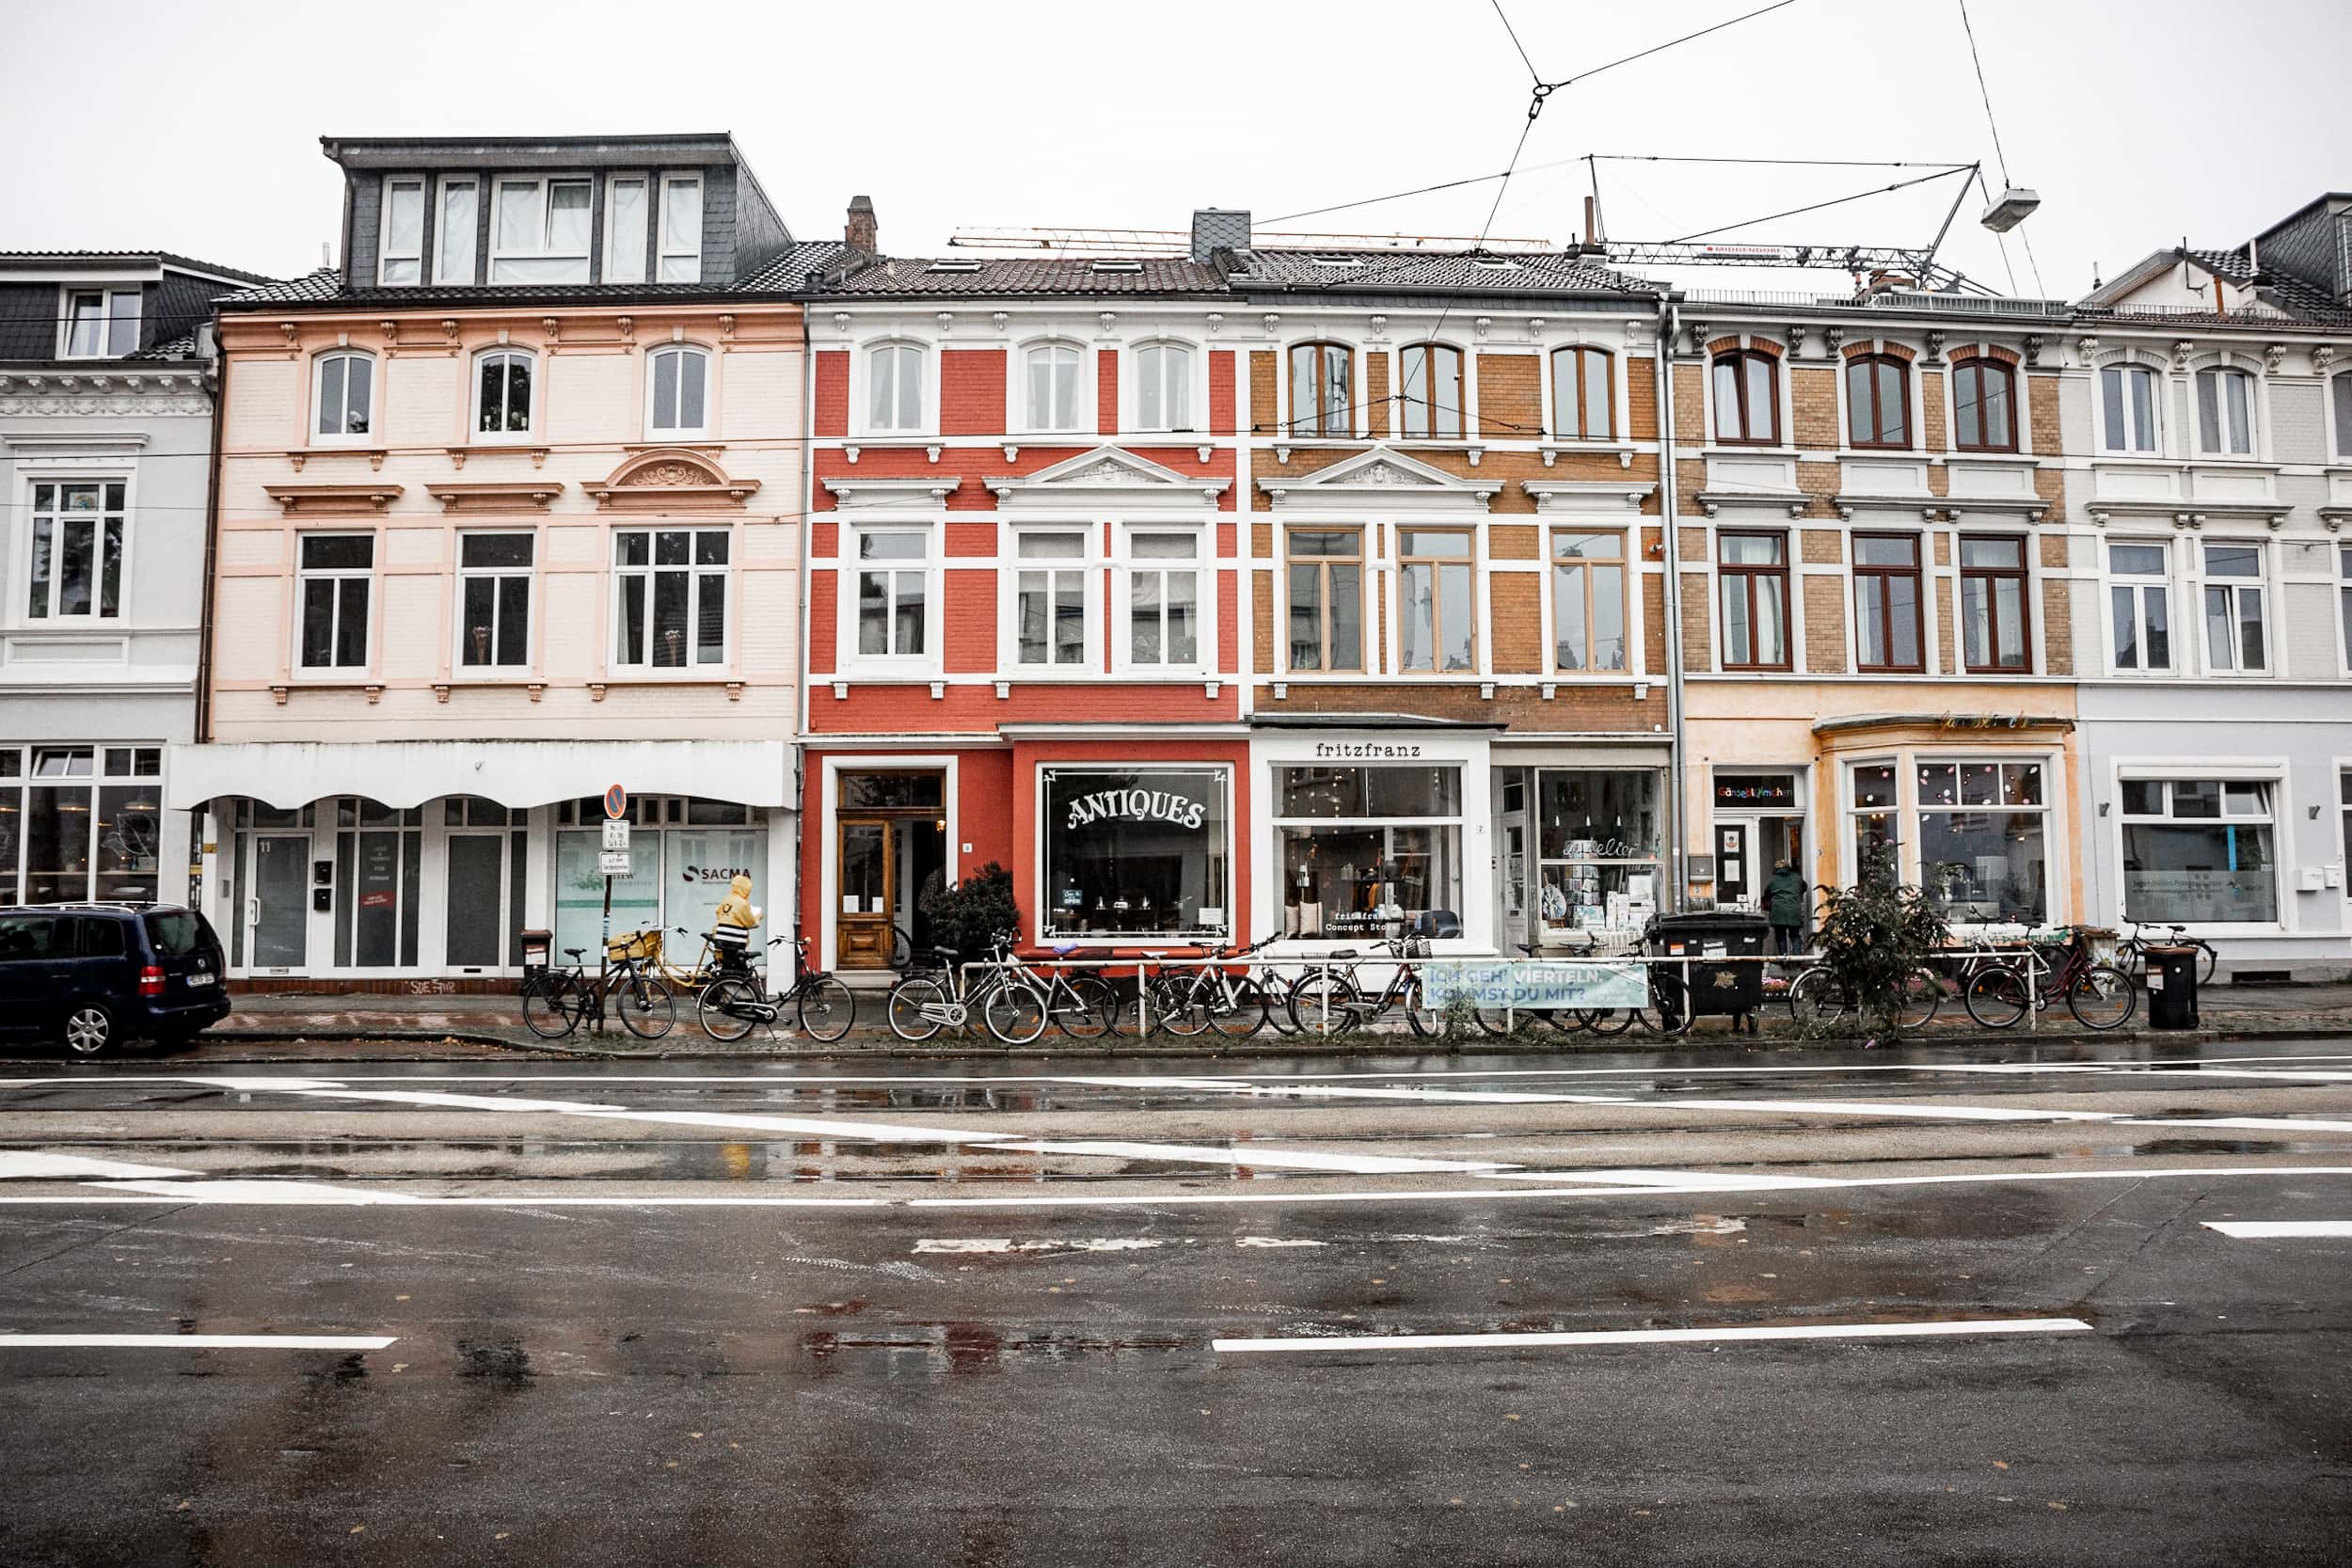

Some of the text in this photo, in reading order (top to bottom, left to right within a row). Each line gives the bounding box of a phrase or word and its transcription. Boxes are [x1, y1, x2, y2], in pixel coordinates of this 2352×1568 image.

[1316, 743, 1421, 757] fritzfranz
[1067, 789, 1206, 829] ANTIQUES
[260, 840, 271, 853] 11
[1326, 923, 1364, 932] Concept
[1513, 988, 1539, 1002] DU
[1545, 988, 1585, 1001] MIT?
